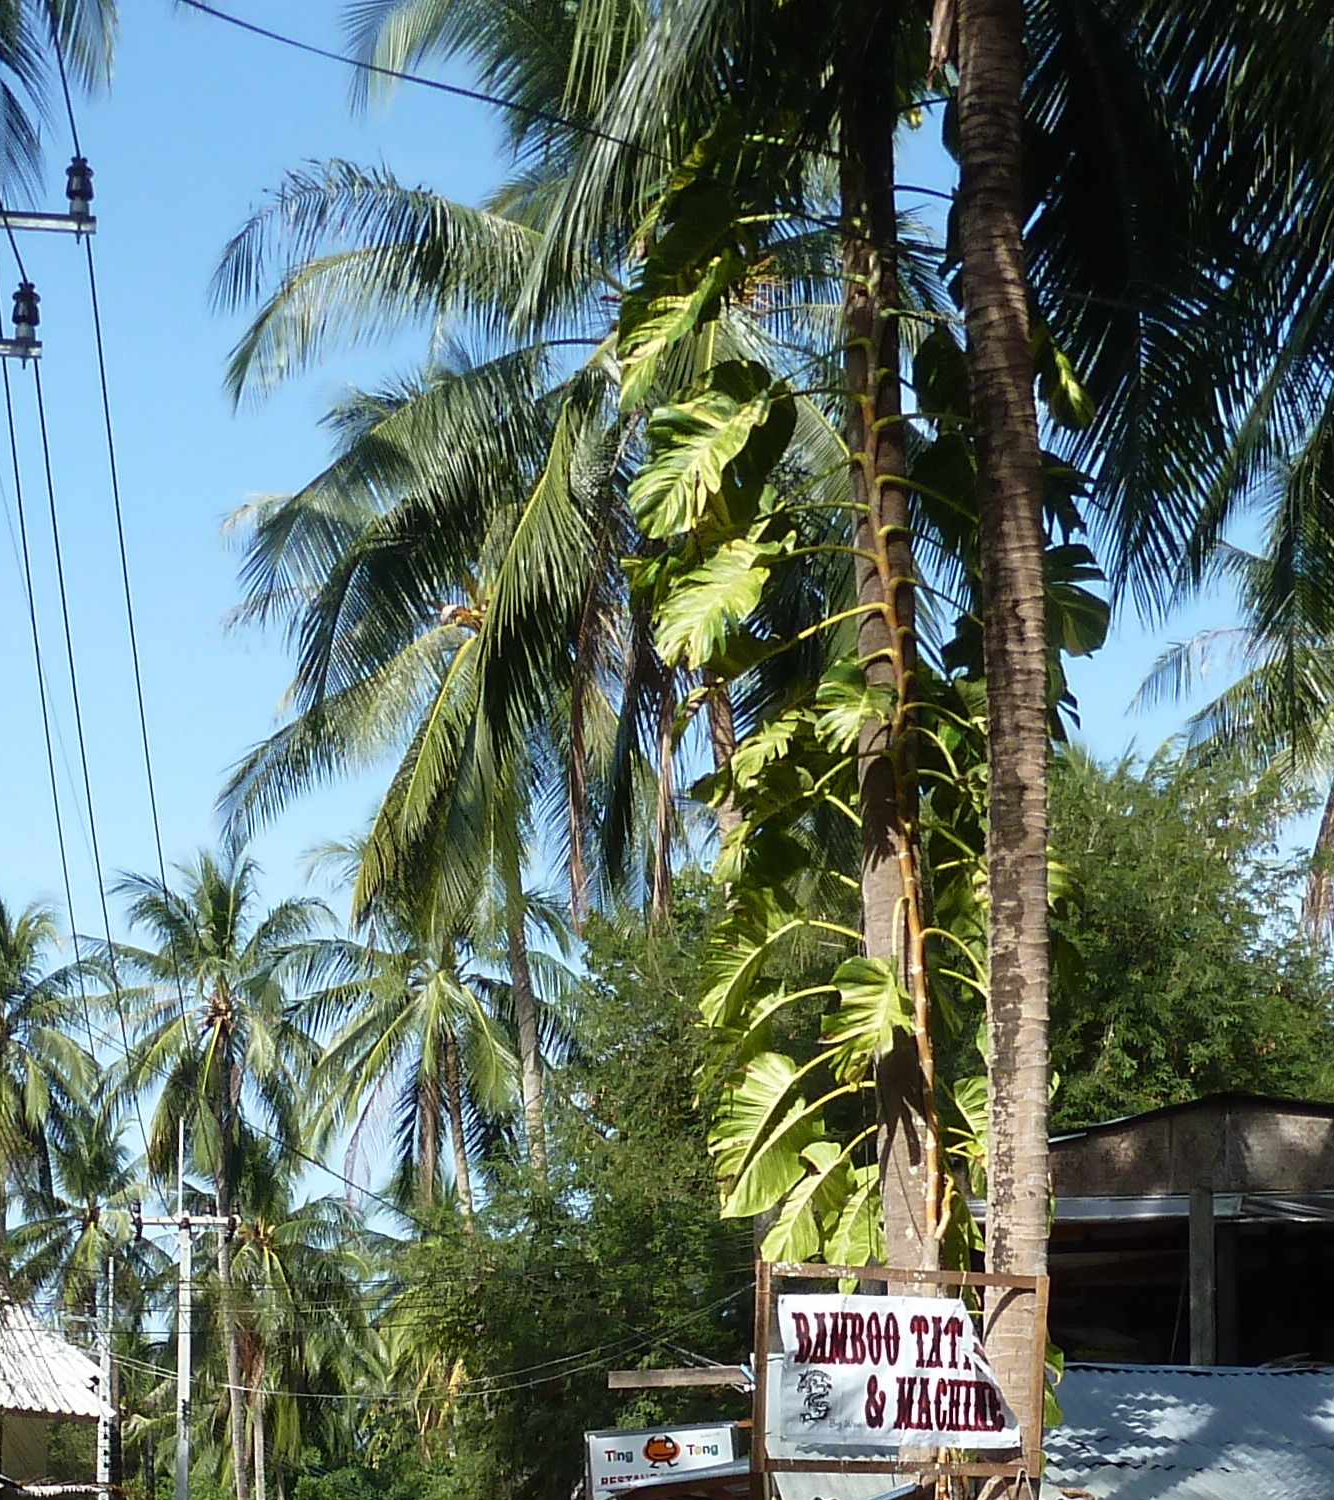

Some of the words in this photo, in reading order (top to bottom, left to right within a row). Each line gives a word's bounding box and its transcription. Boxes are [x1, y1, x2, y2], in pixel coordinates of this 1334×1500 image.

[791, 1311, 901, 1366] BAMBOO
[909, 1315, 972, 1370] TAT
[864, 1374, 886, 1429] &
[604, 1450, 634, 1463] Ting
[686, 1444, 719, 1457] Tong
